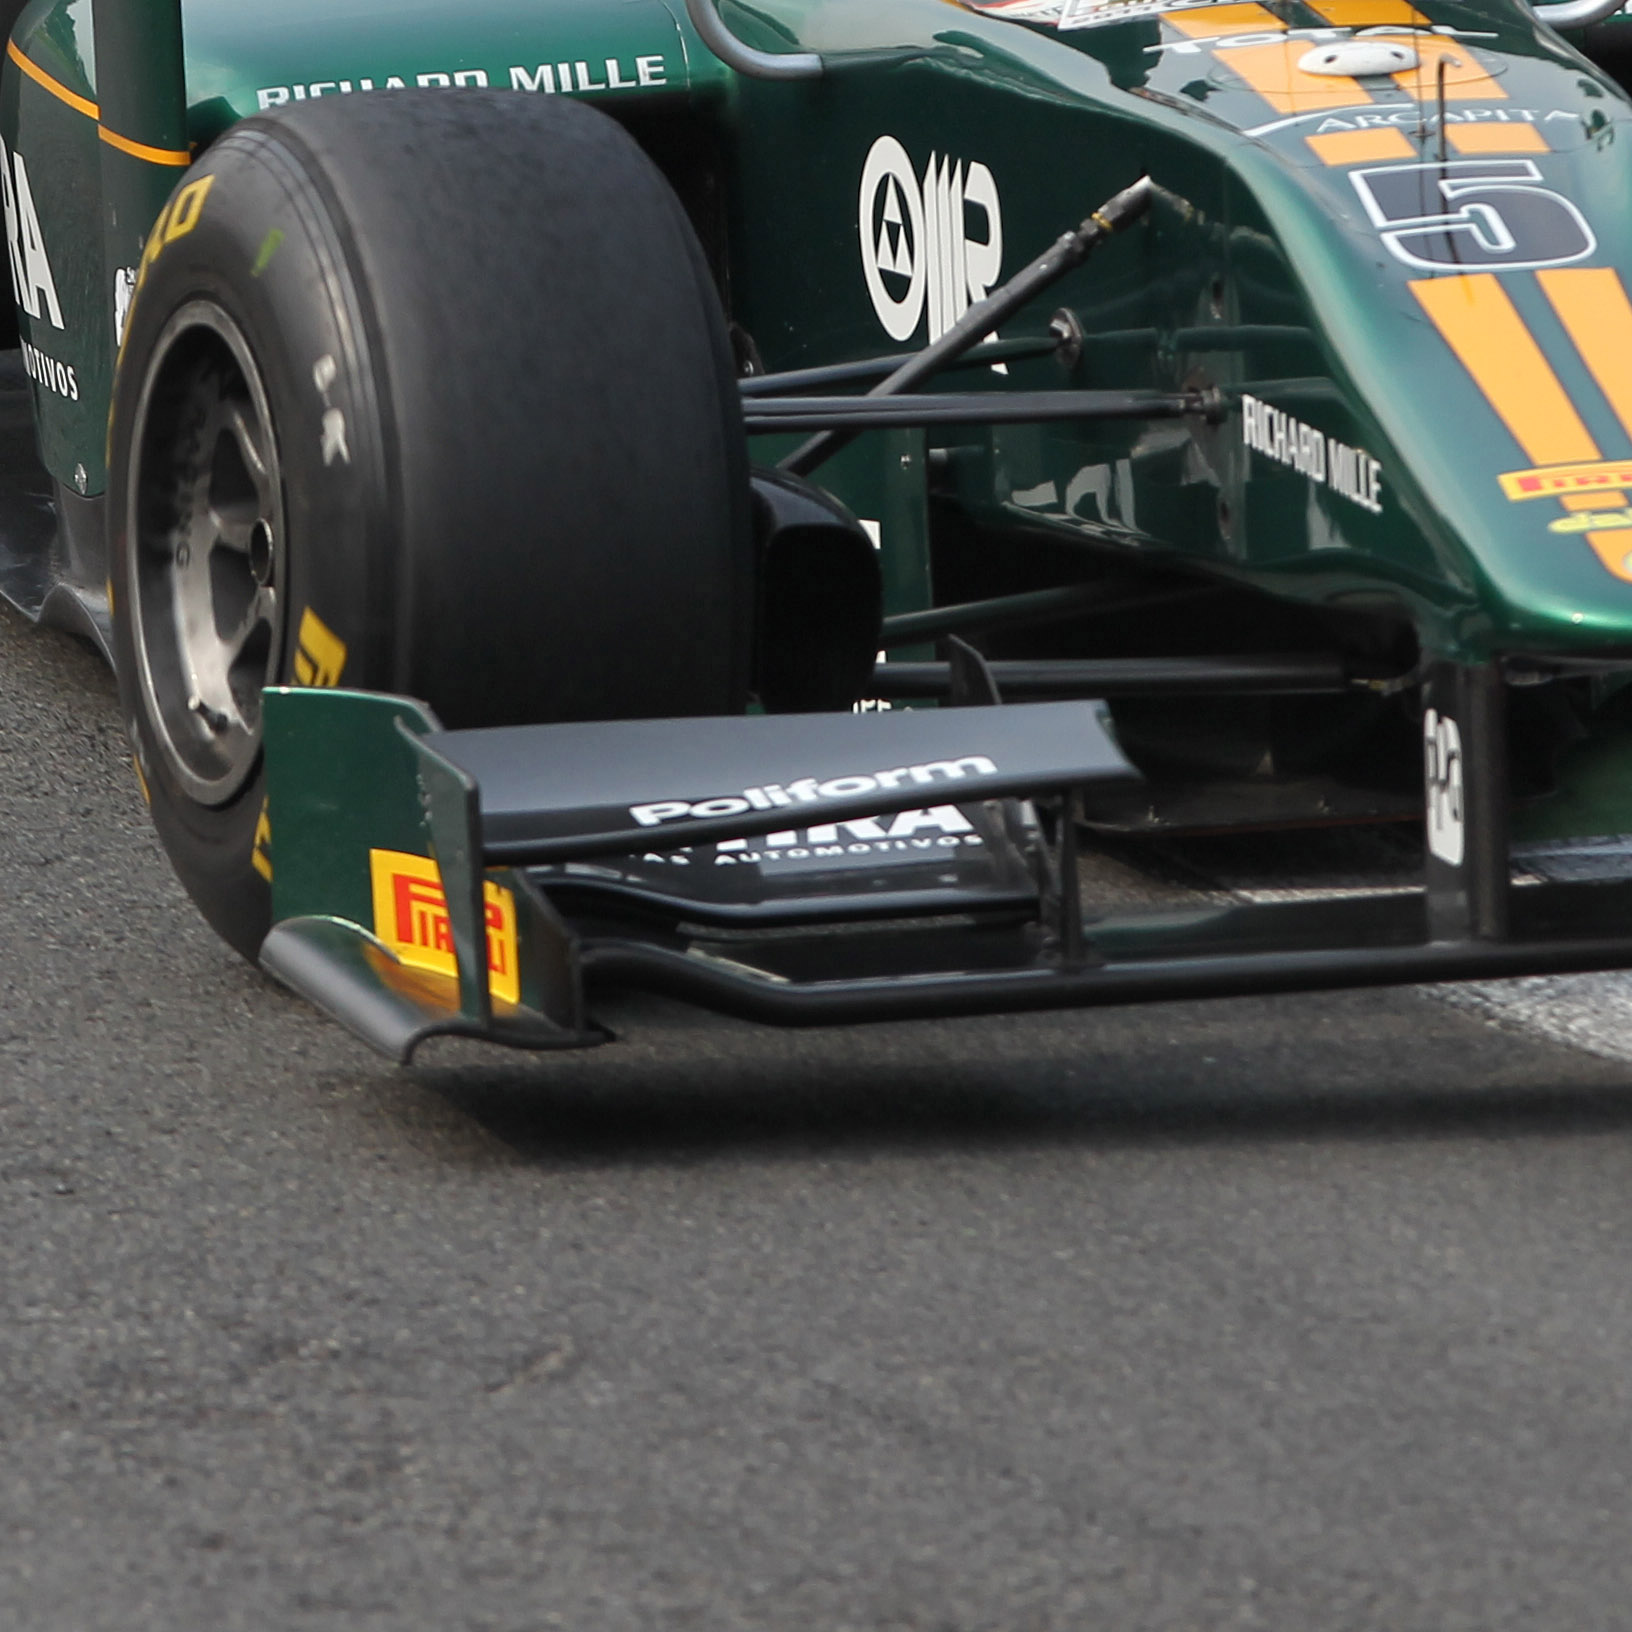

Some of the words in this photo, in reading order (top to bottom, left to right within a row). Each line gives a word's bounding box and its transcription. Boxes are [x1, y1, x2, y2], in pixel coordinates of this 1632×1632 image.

[508, 55, 668, 95] MILLE
[1316, 108, 1580, 133] ARCAPITA
[1348, 159, 1598, 269] 5
[1242, 394, 1326, 482] RICHARD
[1327, 437, 1384, 514] MILLE
[629, 755, 999, 828] Poliform
[714, 834, 985, 866] AUTOMOTIVOS
